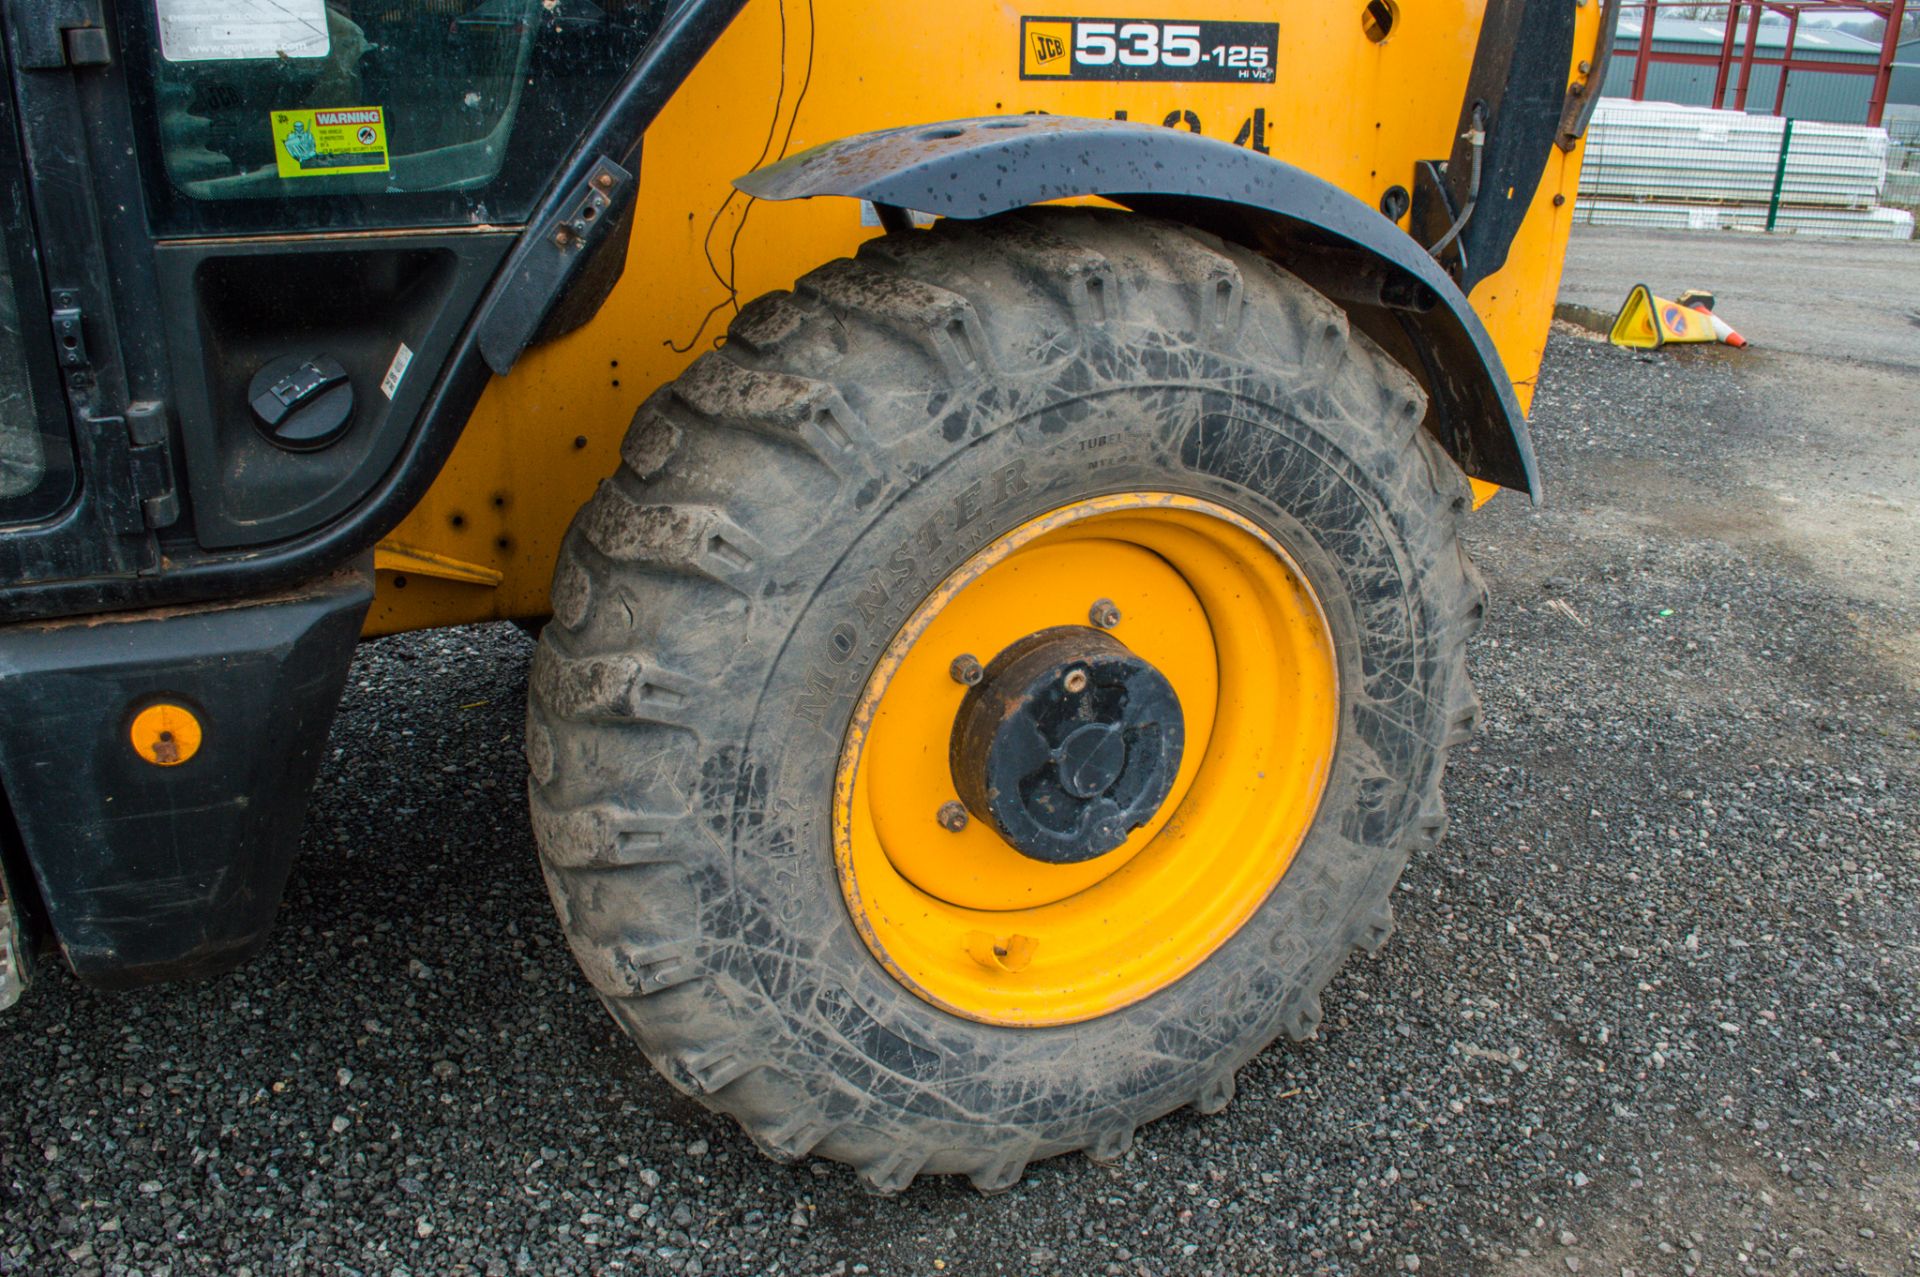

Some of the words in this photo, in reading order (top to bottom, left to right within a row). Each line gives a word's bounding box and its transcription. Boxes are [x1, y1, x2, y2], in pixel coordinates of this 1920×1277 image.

[1036, 35, 1063, 62] JCB
[1075, 23, 1269, 68] 535-125
[1238, 70, 1249, 78] Hi
[1252, 69, 1267, 79] Viz
[317, 111, 379, 124] WARNING
[1079, 432, 1151, 451] TUBEL
[794, 458, 1030, 729] MONSTER
